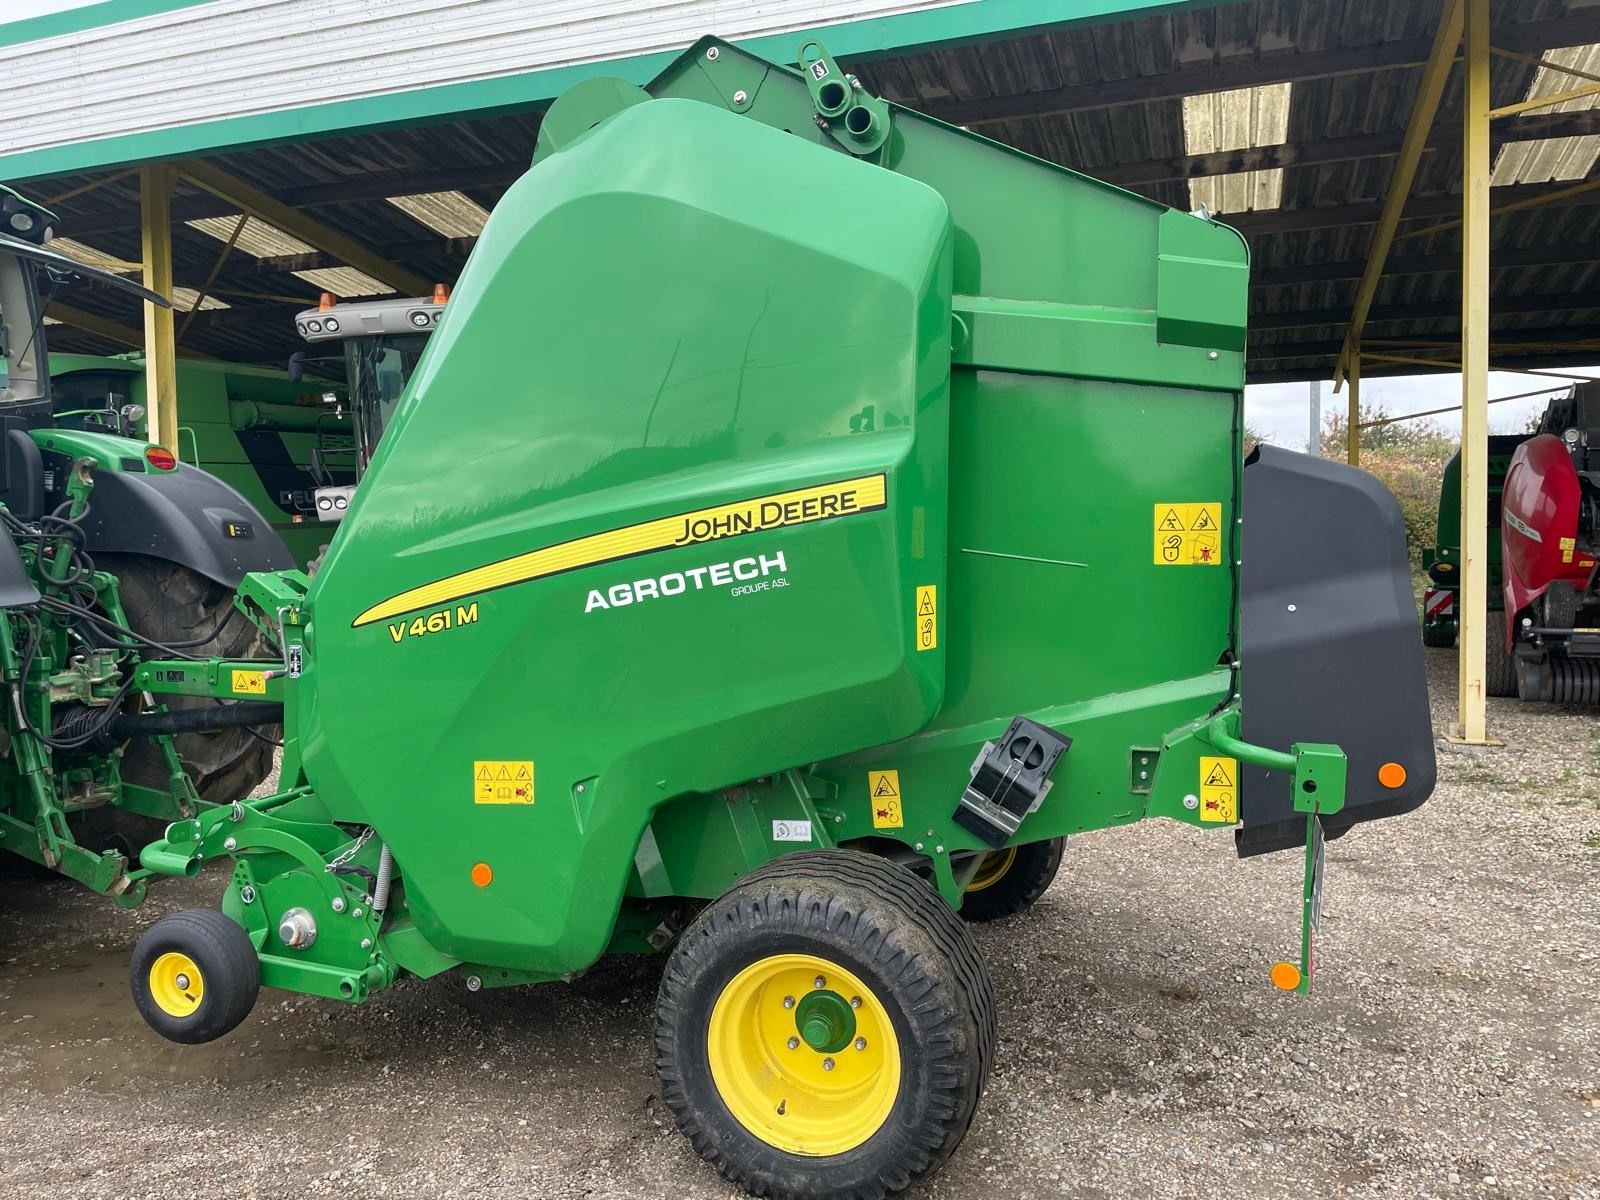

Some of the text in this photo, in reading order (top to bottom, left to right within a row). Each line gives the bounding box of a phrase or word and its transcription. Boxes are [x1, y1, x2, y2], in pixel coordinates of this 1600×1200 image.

[675, 490, 858, 543] JOHN DEERE
[584, 551, 788, 613] AGROTECH
[731, 577, 790, 597] GROUPE ASL
[388, 602, 479, 643] V 461 M
